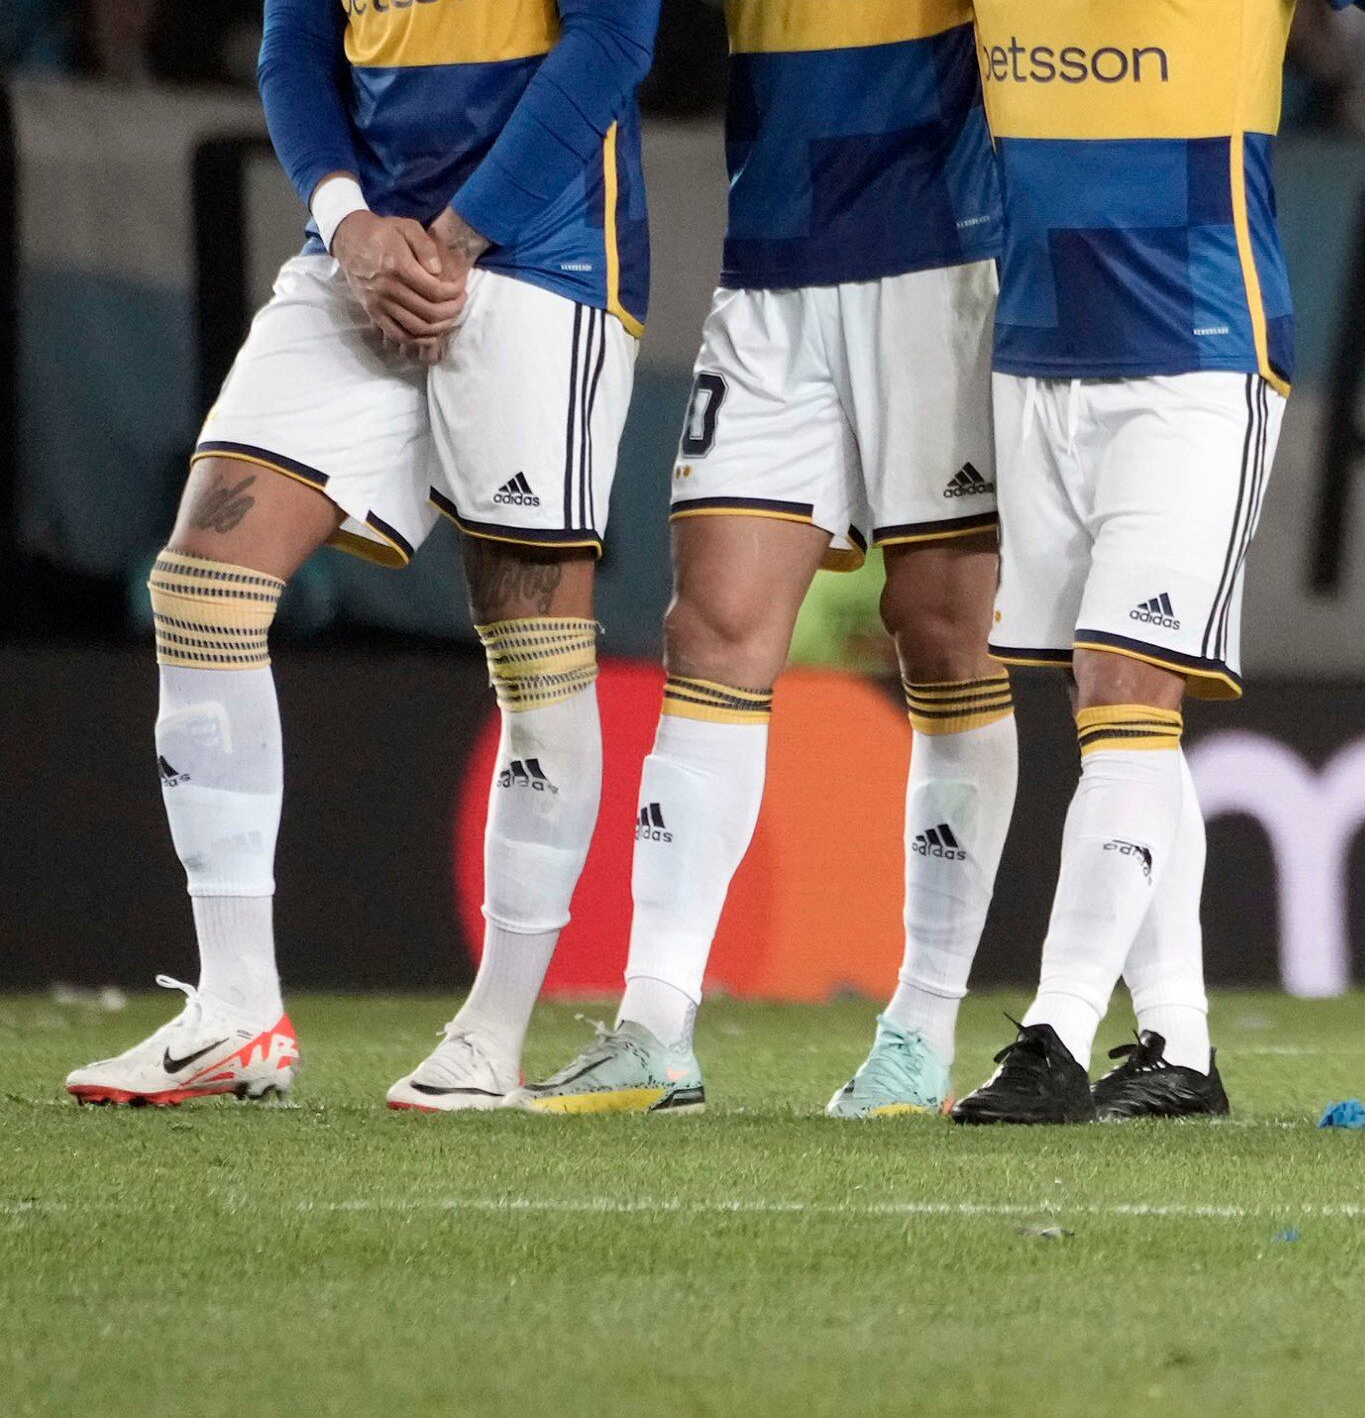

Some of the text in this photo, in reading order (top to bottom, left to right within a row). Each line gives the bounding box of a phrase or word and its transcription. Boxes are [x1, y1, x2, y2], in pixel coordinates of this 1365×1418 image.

[492, 491, 541, 507] adidas
[1128, 607, 1181, 631] adidas
[911, 840, 967, 861] adidas
